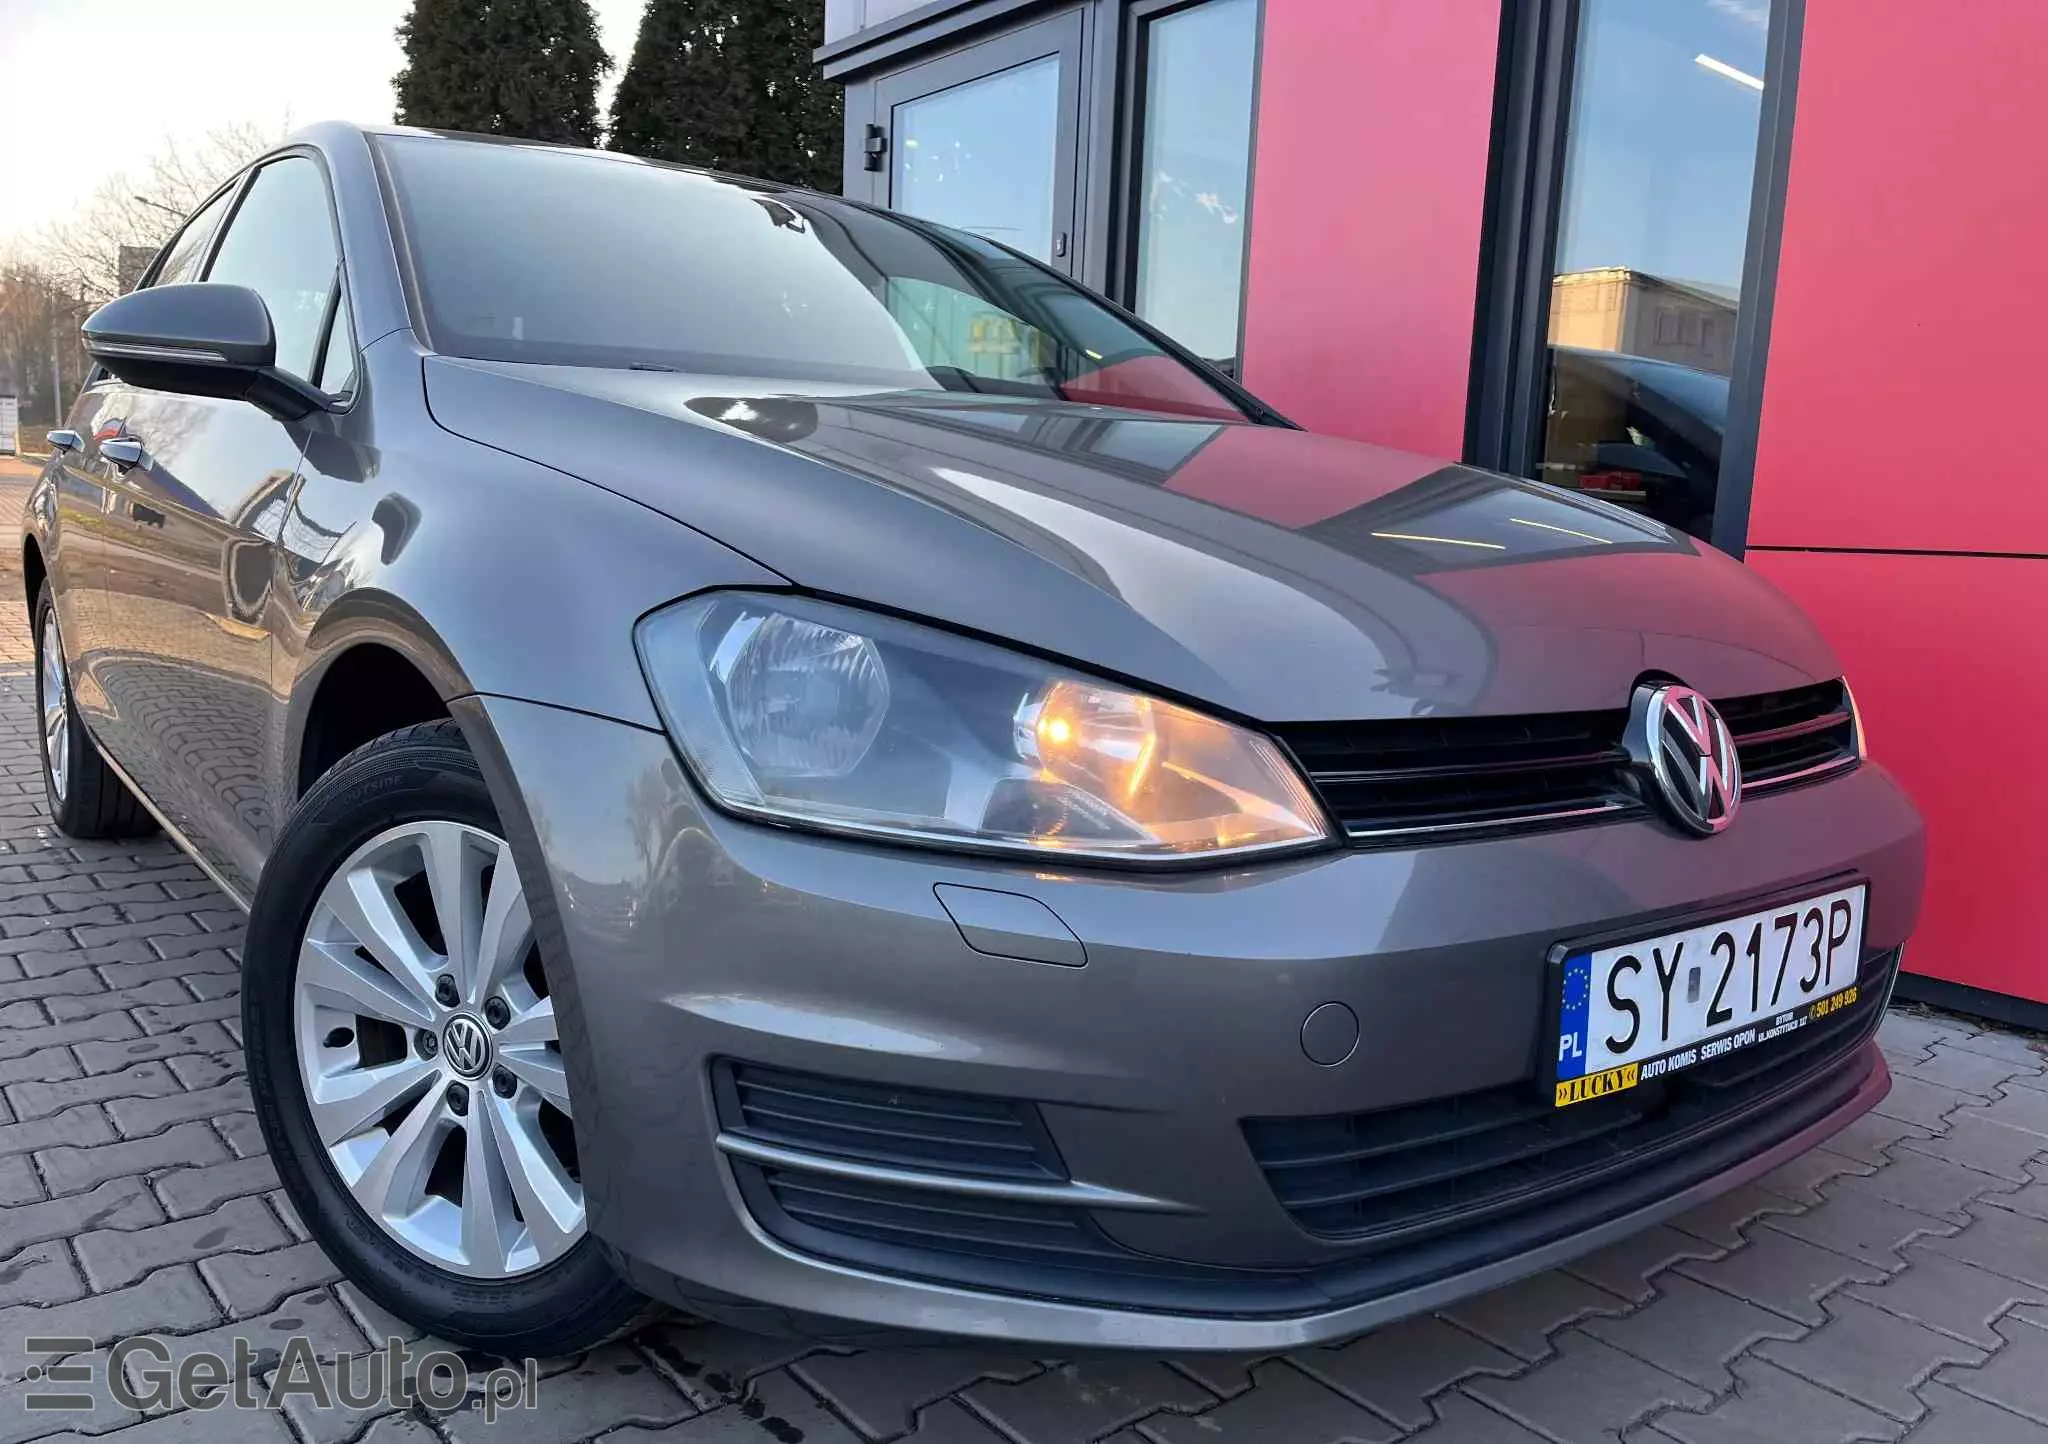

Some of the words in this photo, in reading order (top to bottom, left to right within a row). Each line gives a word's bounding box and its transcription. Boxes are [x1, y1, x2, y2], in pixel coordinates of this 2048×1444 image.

[1605, 941, 1684, 1054] SY
[1706, 898, 1852, 1027] 2173P
[1558, 1034, 1583, 1062] PL
[1641, 1060, 1667, 1081] AUTO
[1668, 1049, 1698, 1072] KOMIS
[1700, 1036, 1732, 1060] SERWIS
[1734, 1028, 1756, 1049] OPON
